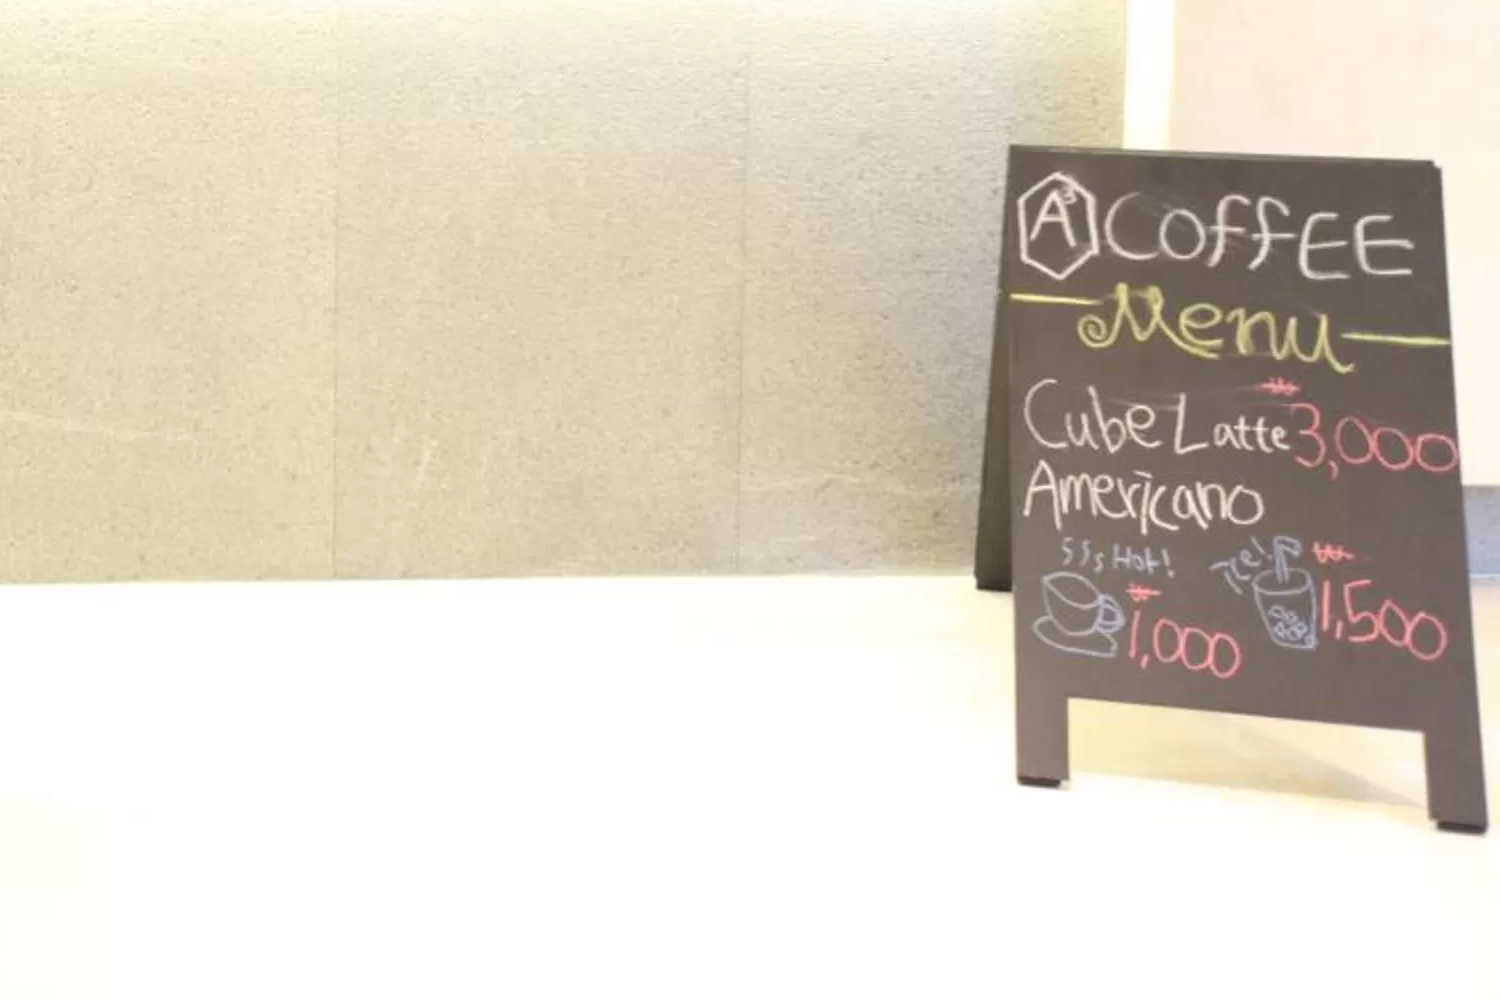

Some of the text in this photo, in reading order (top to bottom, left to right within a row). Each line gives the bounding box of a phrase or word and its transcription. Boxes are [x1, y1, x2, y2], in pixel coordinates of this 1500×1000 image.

[1076, 283, 1356, 375] Menu
[1023, 379, 1461, 481] Cube Latte 3,000
[1023, 460, 1266, 536] Americano
[1128, 610, 1242, 680] 1,000
[1321, 580, 1449, 662] 1,500
